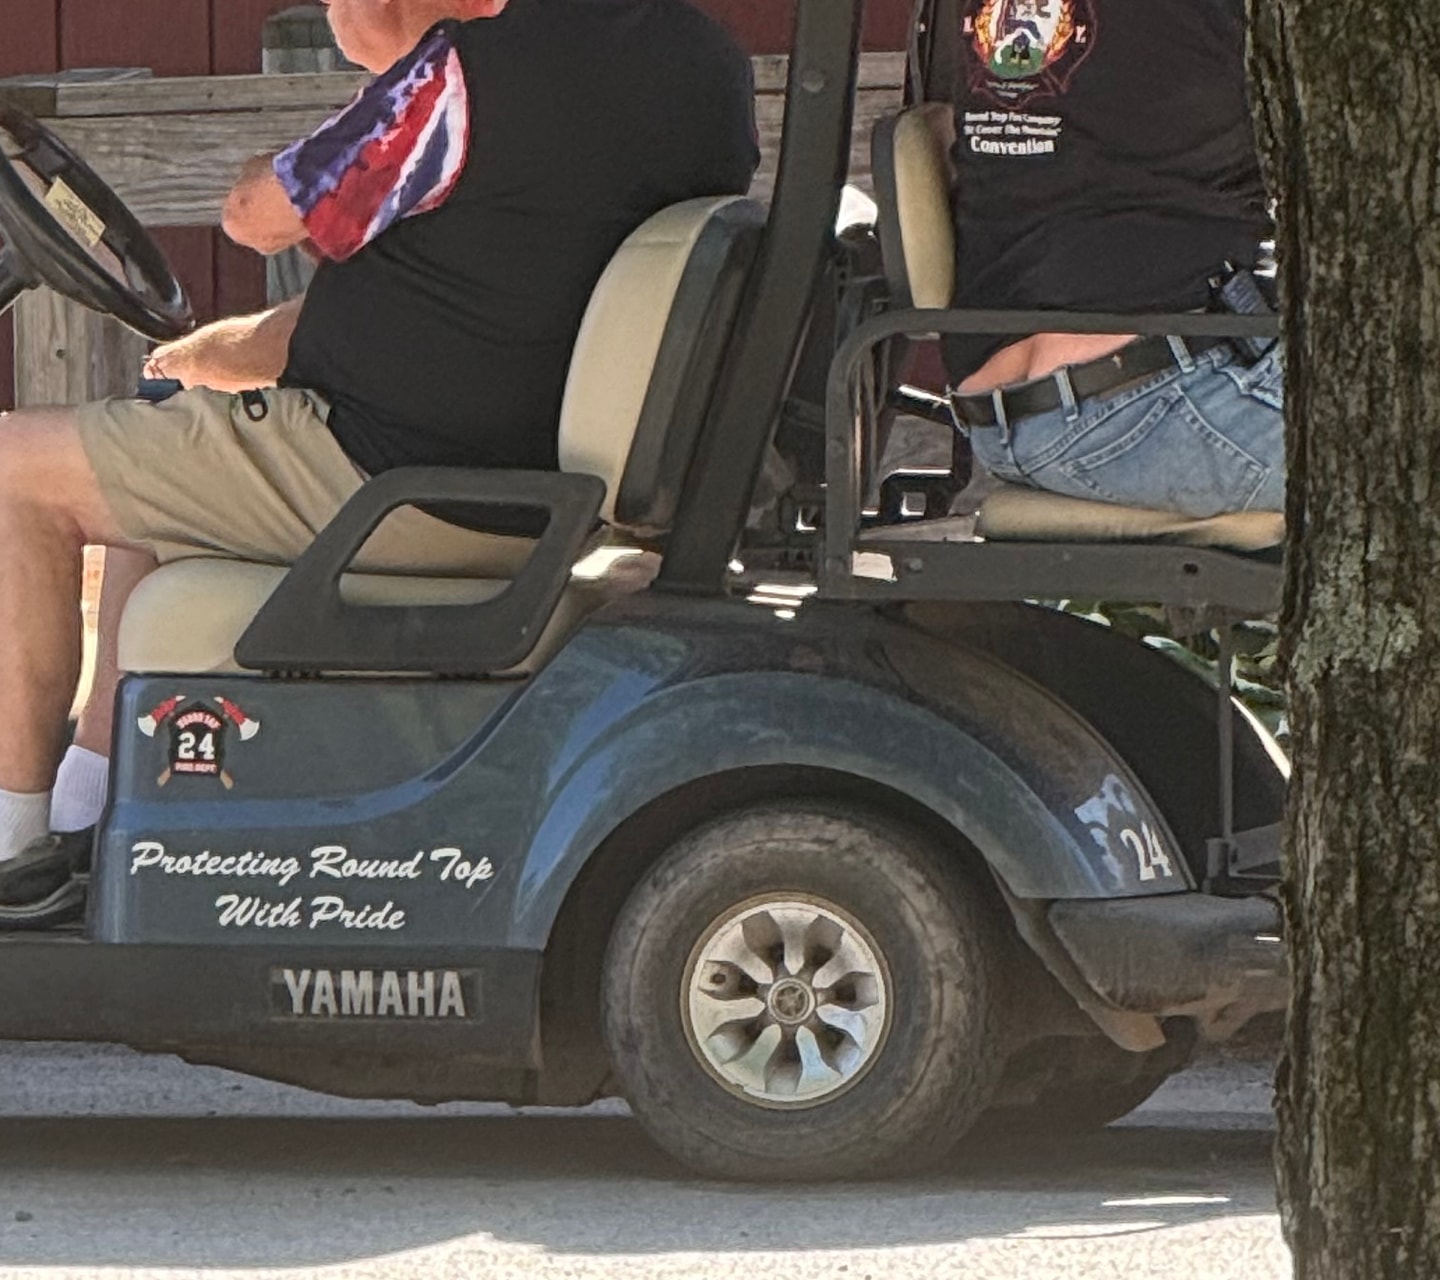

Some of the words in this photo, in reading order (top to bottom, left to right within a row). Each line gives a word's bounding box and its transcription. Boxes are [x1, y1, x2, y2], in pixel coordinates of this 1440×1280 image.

[970, 136, 1055, 155] Convention
[177, 732, 216, 760] 24
[130, 841, 301, 886] Protecting
[310, 845, 424, 878] Round
[429, 847, 495, 889] Top
[1120, 822, 1173, 881] 24
[215, 894, 302, 928] With
[310, 895, 405, 930] Pride
[282, 968, 466, 1017] YAMAHA
